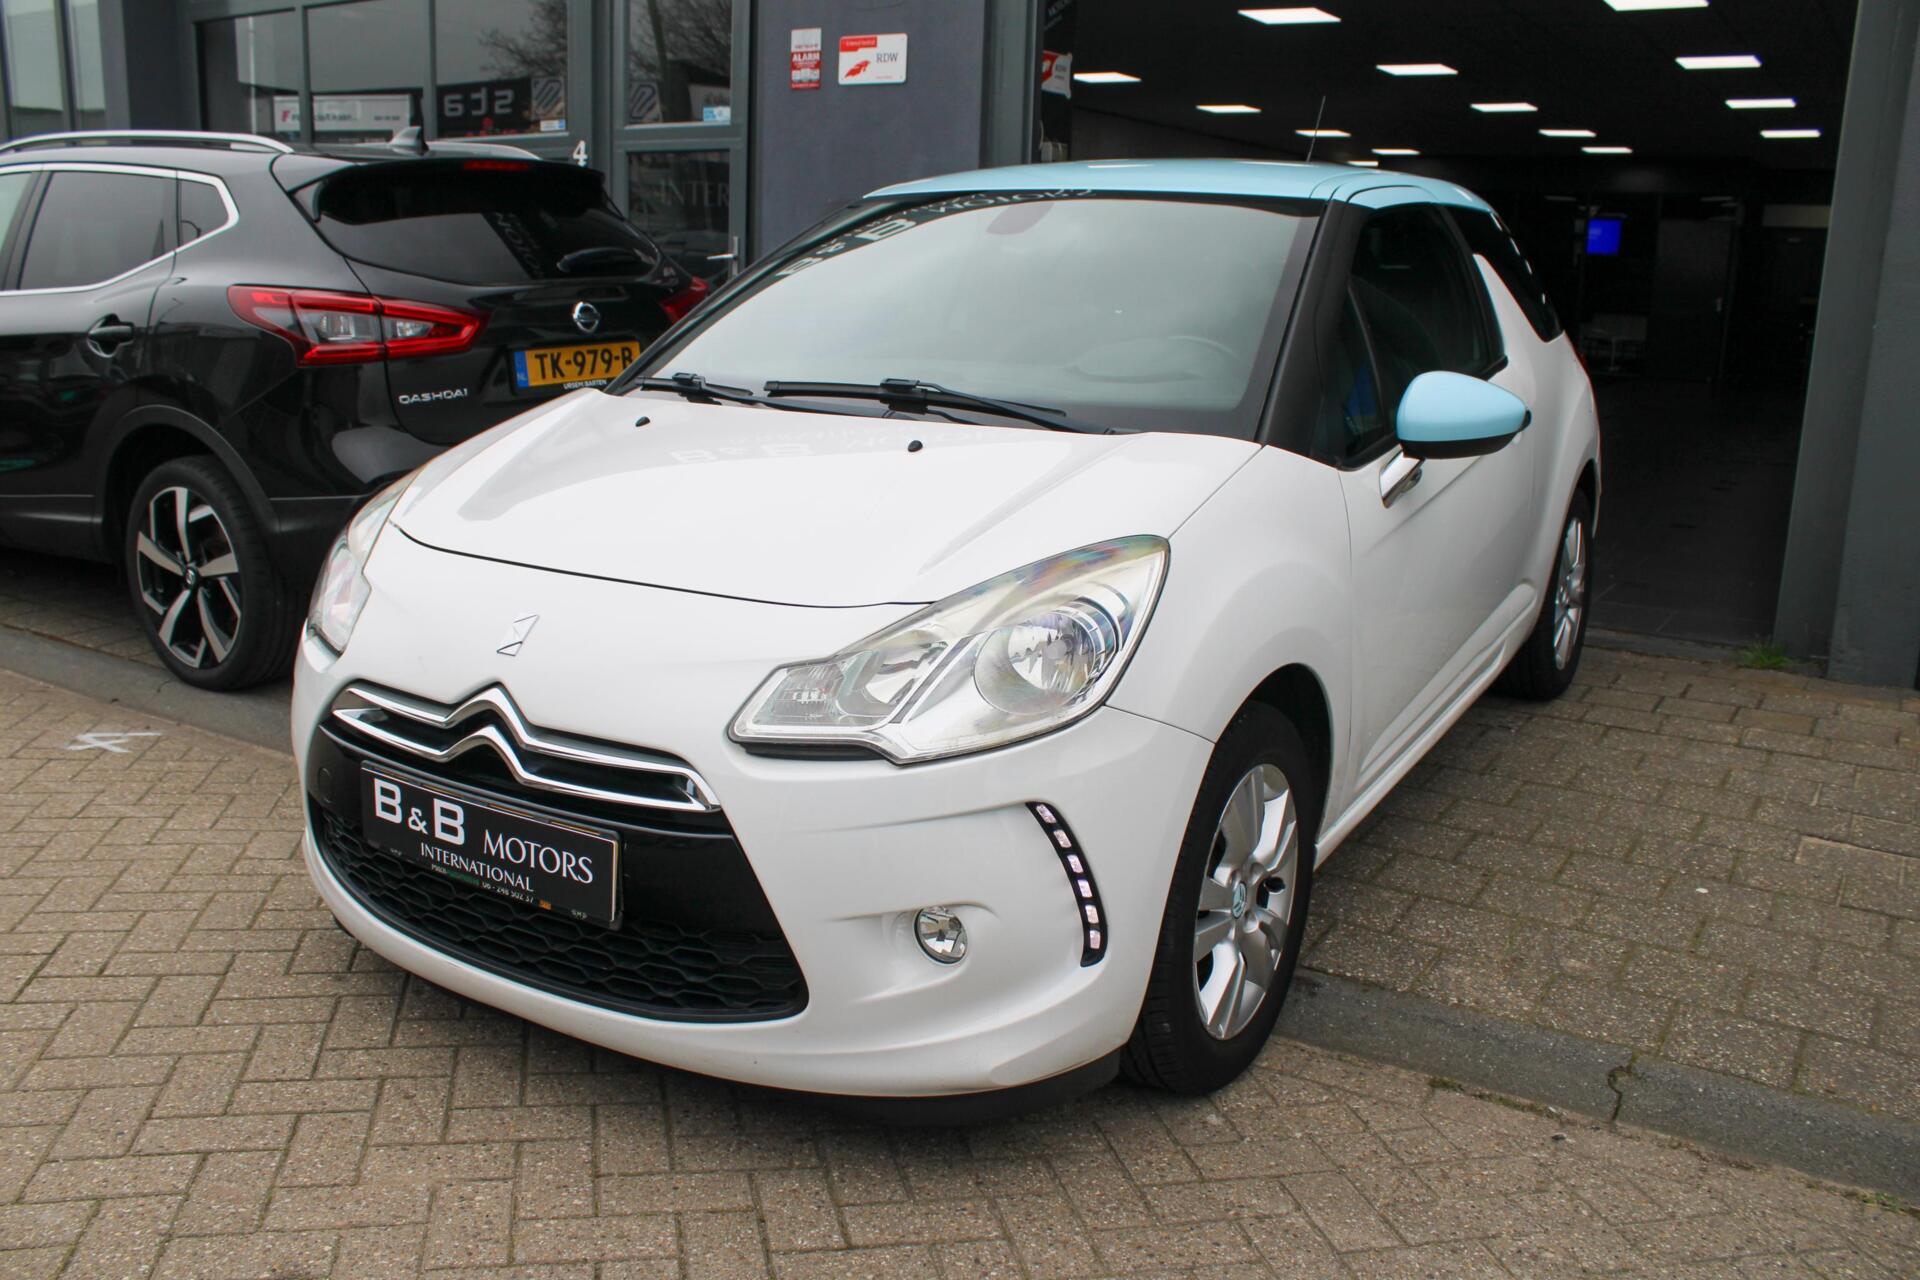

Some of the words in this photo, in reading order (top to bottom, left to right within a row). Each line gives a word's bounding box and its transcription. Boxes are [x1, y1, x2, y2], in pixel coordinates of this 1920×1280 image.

[792, 52, 821, 62] ALARM
[876, 52, 899, 63] RDW
[573, 139, 588, 167] 4
[535, 347, 633, 379] TK-979-B
[420, 842, 534, 892] INTERNATIONAL
[483, 829, 593, 884] MOTORS
